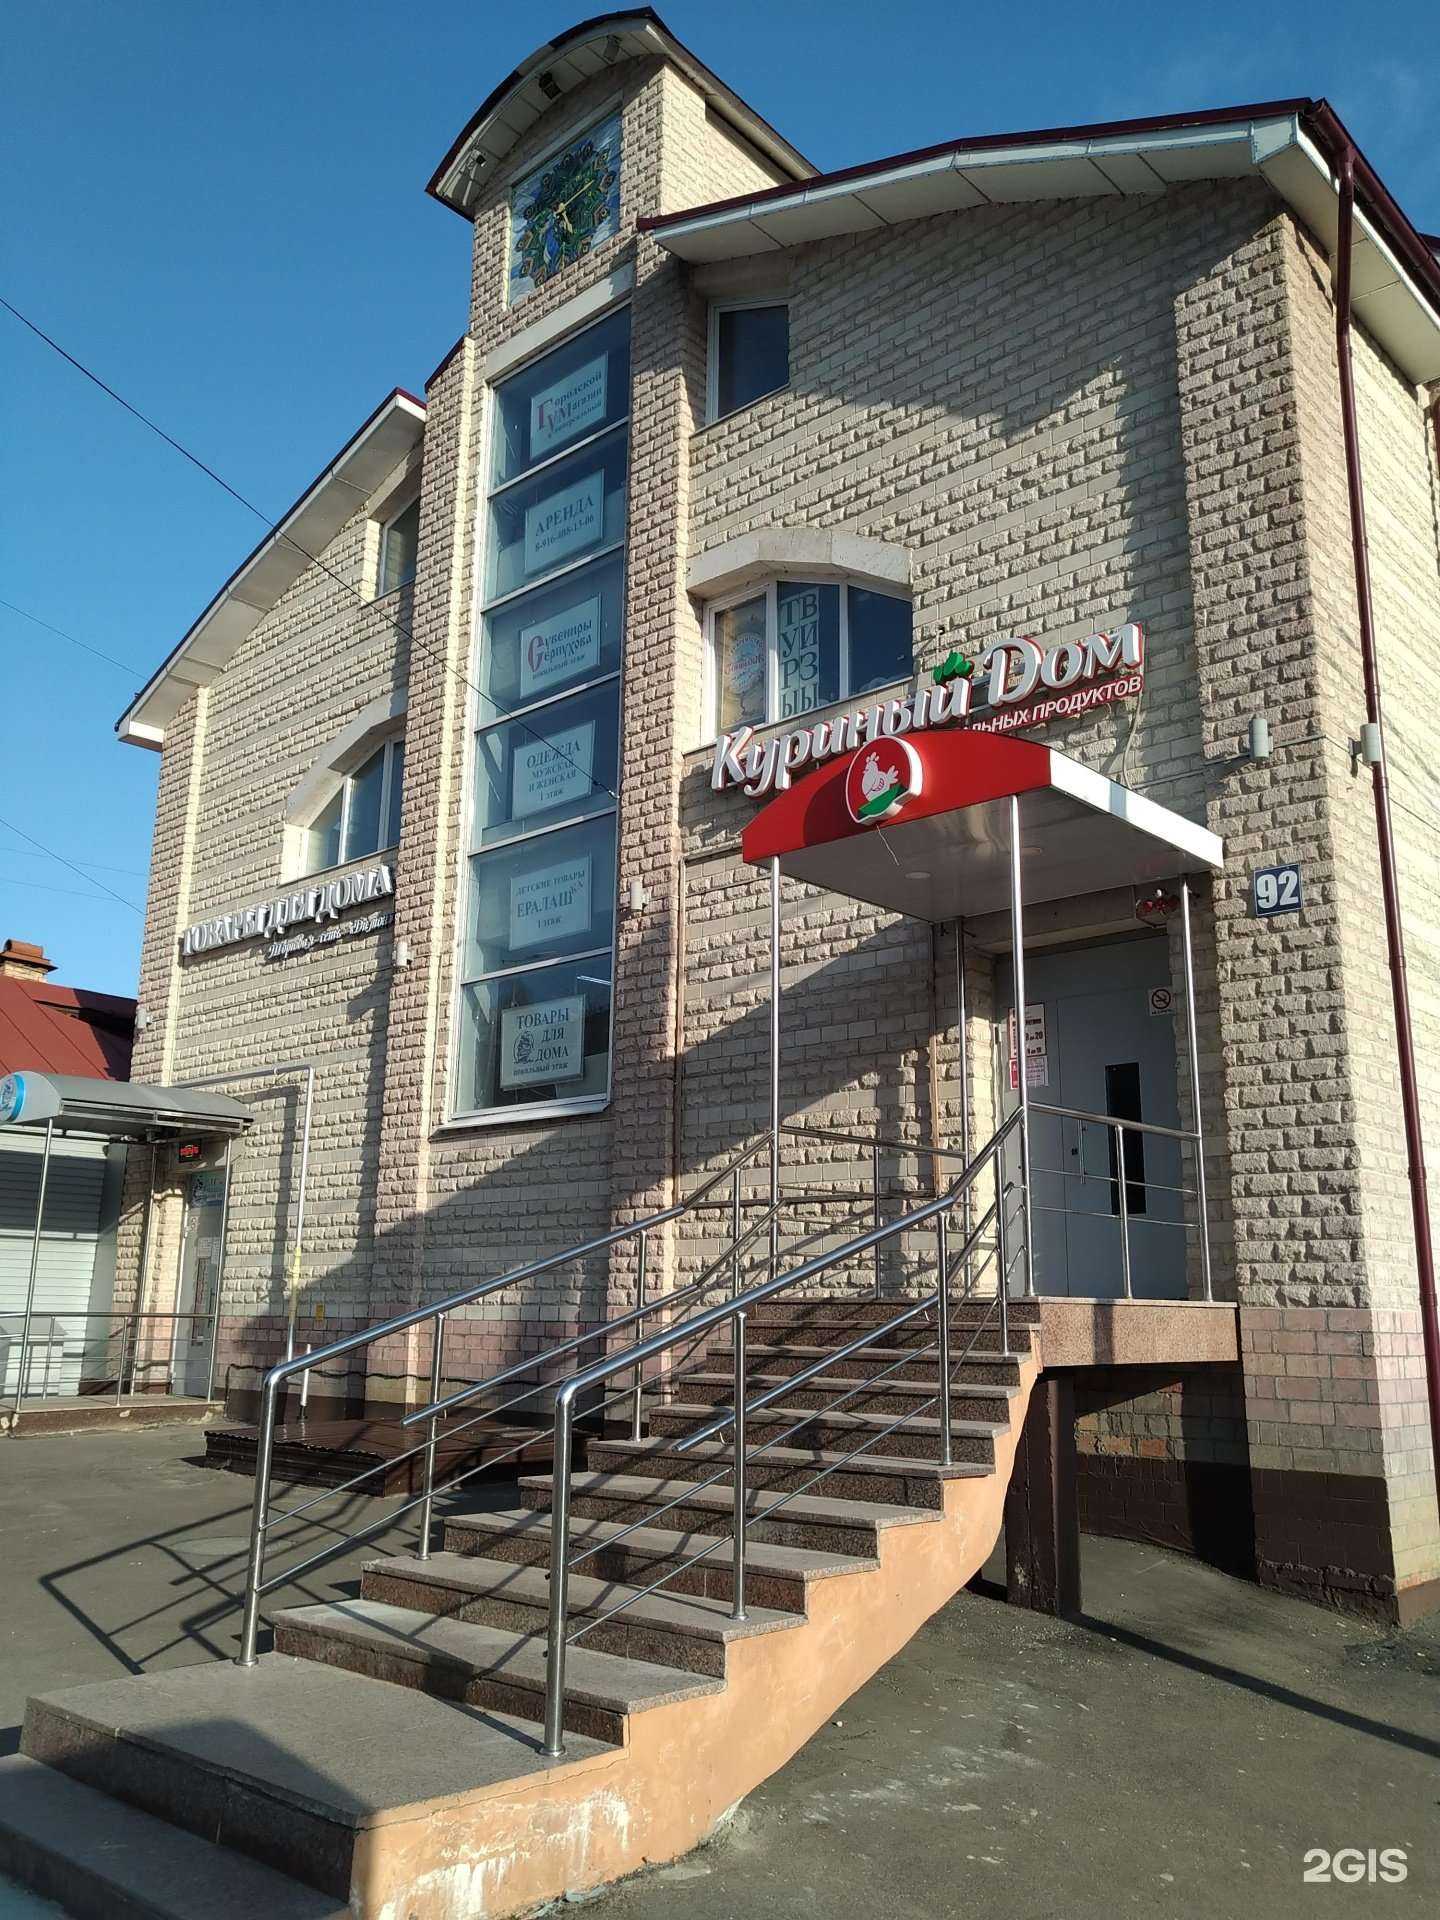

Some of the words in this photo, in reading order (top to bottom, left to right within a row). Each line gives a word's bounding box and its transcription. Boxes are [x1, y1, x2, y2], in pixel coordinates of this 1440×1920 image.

[535, 495, 594, 536] АРЕНДА
[982, 624, 1144, 706] Дом
[1031, 676, 1142, 721] ПРОДУКТОВ
[711, 652, 972, 798] Куриный
[527, 739, 581, 769] ОДЕЖДА
[315, 865, 395, 924] ДОМА
[517, 890, 573, 918] ЕРАЛАШ
[1256, 870, 1300, 909] 92
[517, 1007, 569, 1029] ТОВАРЫ
[541, 1027, 565, 1044] ДЛЯ
[535, 1045, 569, 1063] ДОМА
